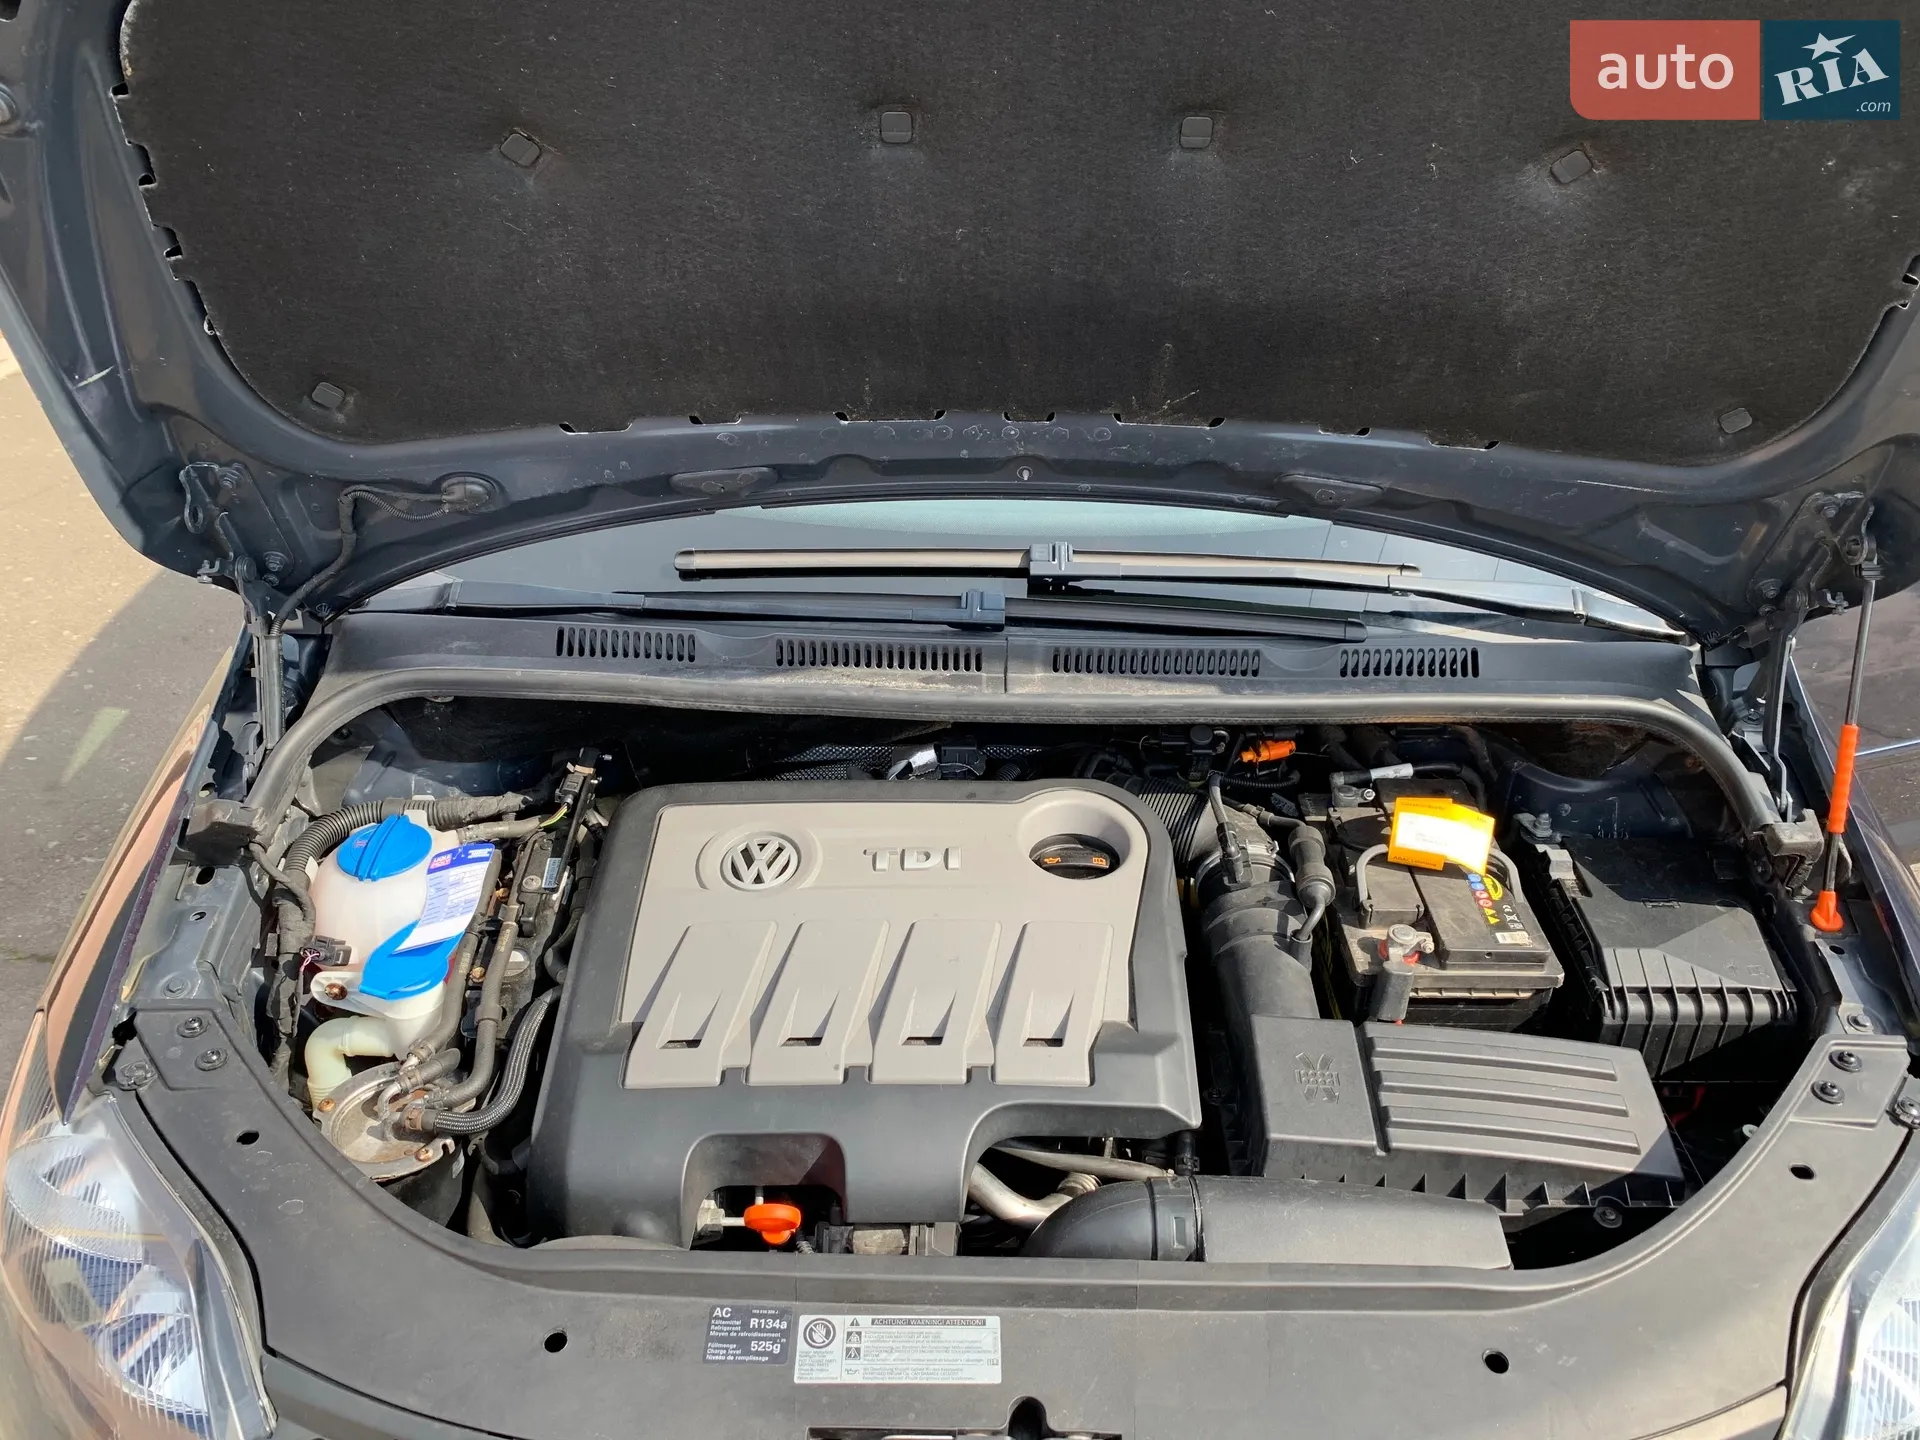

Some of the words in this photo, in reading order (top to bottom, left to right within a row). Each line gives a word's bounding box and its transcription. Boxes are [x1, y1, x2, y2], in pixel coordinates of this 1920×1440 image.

[864, 847, 963, 872] TDI
[712, 1307, 732, 1318] AC
[749, 1318, 788, 1329] R134a
[750, 1341, 781, 1354] 525g
